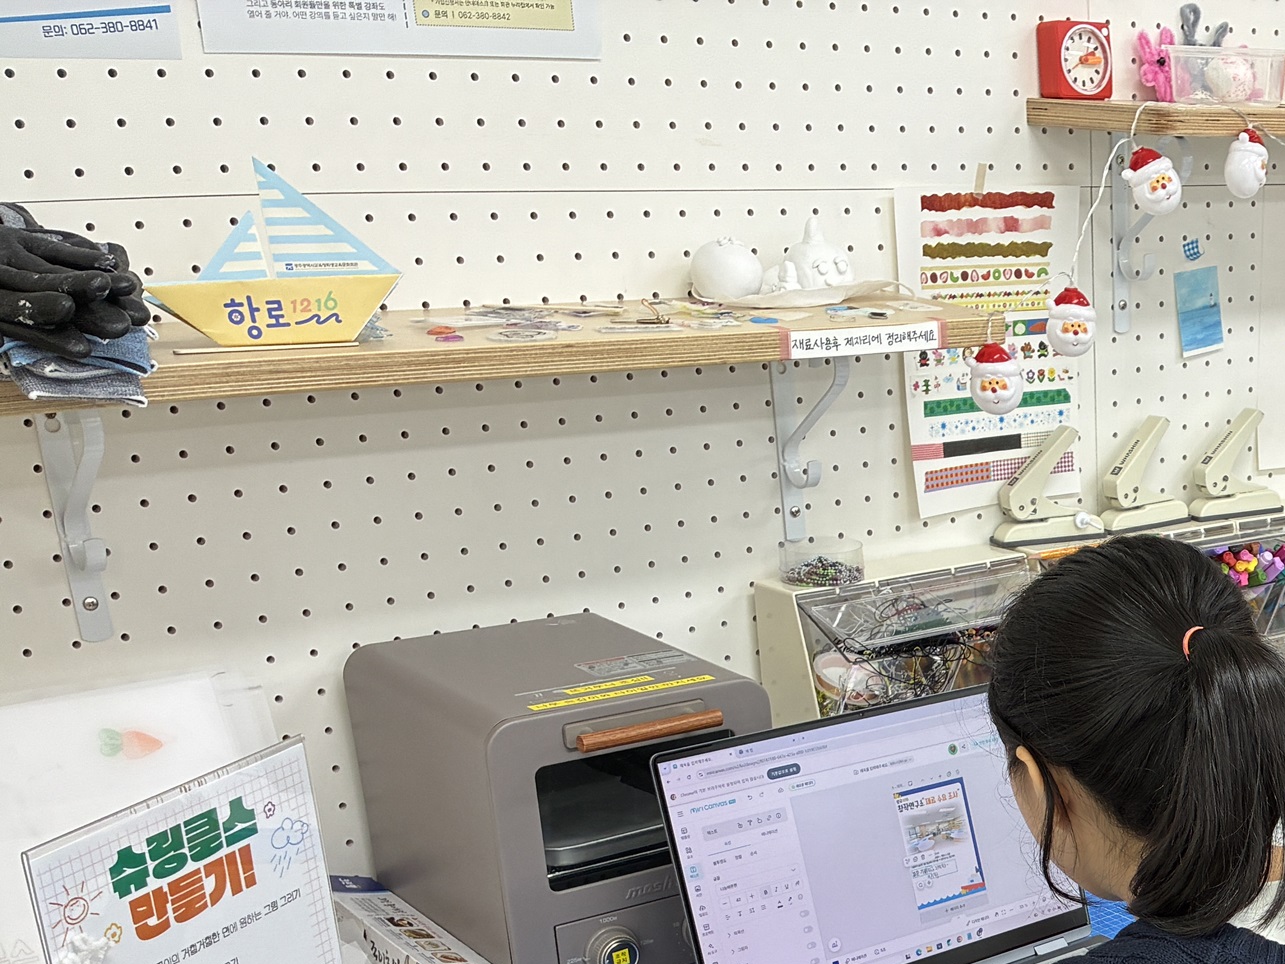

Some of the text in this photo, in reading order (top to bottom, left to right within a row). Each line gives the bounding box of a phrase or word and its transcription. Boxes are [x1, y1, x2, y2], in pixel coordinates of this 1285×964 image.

[293, 11, 307, 19] 어떤
[309, 11, 331, 20] 강의를
[333, 12, 347, 20] 듣고
[371, 13, 385, 21] 말만
[332, 1, 346, 10] 위한
[348, 2, 362, 10] 특별
[364, 2, 385, 11] 강좌도
[435, 11, 511, 20] 문의 062-380-8842
[42, 18, 159, 38] 문의: 062-380-8841
[844, 333, 882, 347] 제자리에
[886, 329, 936, 346] 정리해주세요
[1119, 439, 1140, 466] WHASHIN
[1211, 430, 1233, 455] WHASHIN
[1018, 450, 1043, 476] WHASHIN
[108, 795, 259, 900] 슈링클스
[128, 843, 257, 941] 만들기!
[239, 911, 262, 929] 원하는
[263, 900, 278, 916] 그림
[279, 888, 301, 907] 그리기
